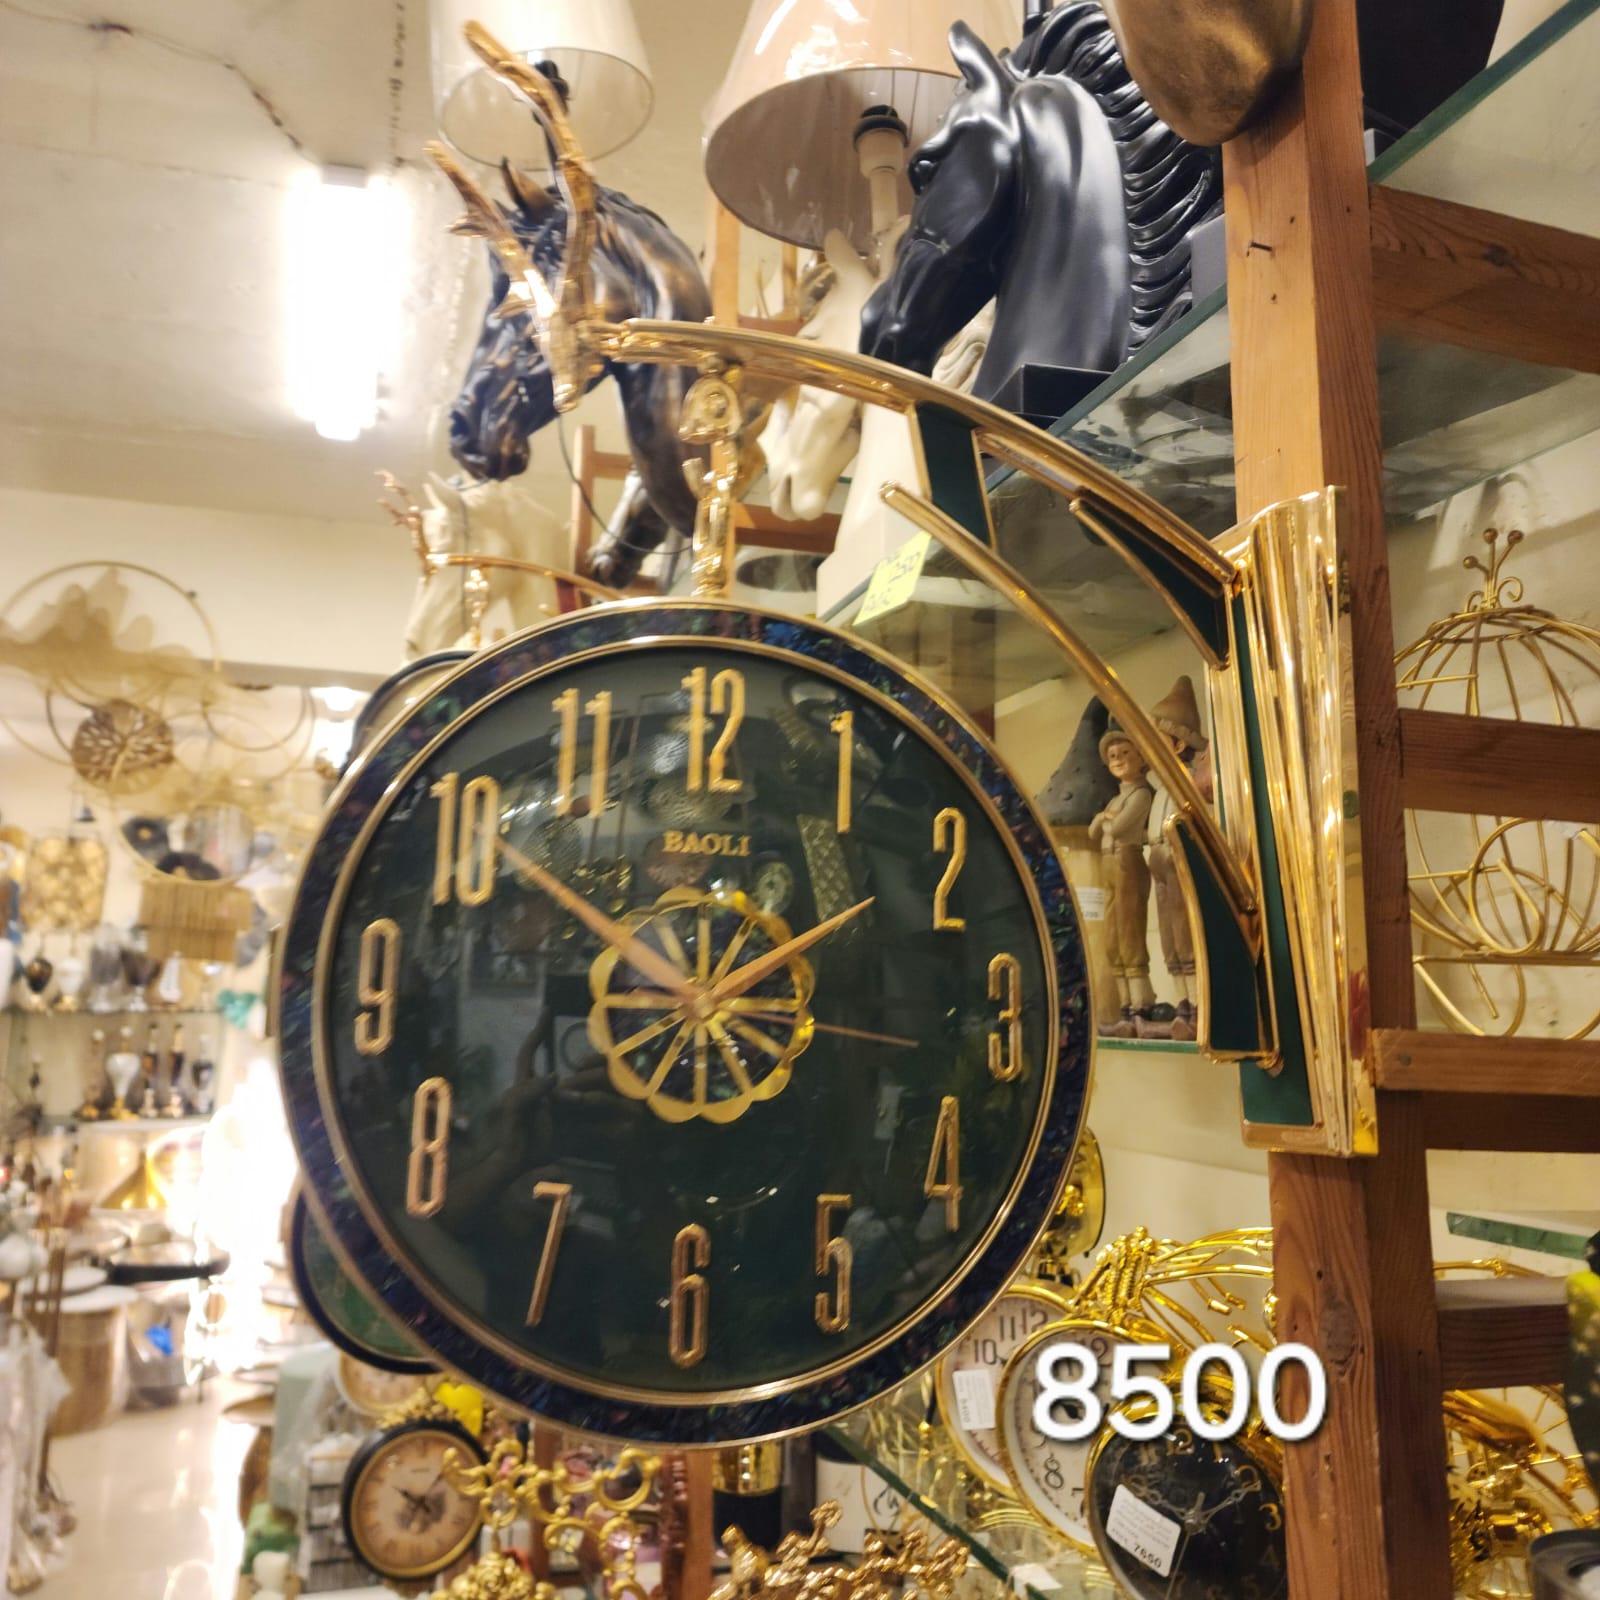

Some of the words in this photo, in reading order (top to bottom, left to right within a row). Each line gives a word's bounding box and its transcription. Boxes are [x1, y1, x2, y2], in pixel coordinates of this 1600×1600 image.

[552, 687, 611, 819] 11
[682, 665, 746, 795] 12
[830, 709, 855, 833] 1
[430, 771, 501, 908] 10
[662, 830, 752, 857] BAOLI
[932, 806, 967, 931] 2
[354, 918, 400, 1055] 9
[987, 952, 1022, 1082] 3
[405, 1076, 452, 1218] 8
[924, 1095, 960, 1231] 4
[524, 1180, 572, 1328] 7
[667, 1222, 711, 1368] 6
[814, 1192, 852, 1333] 5
[973, 1338, 997, 1366] 10
[999, 1315, 1017, 1342] 11
[1022, 1307, 1049, 1335] 12
[1234, 1464, 1262, 1493] 2
[1258, 1502, 1283, 1532] 3
